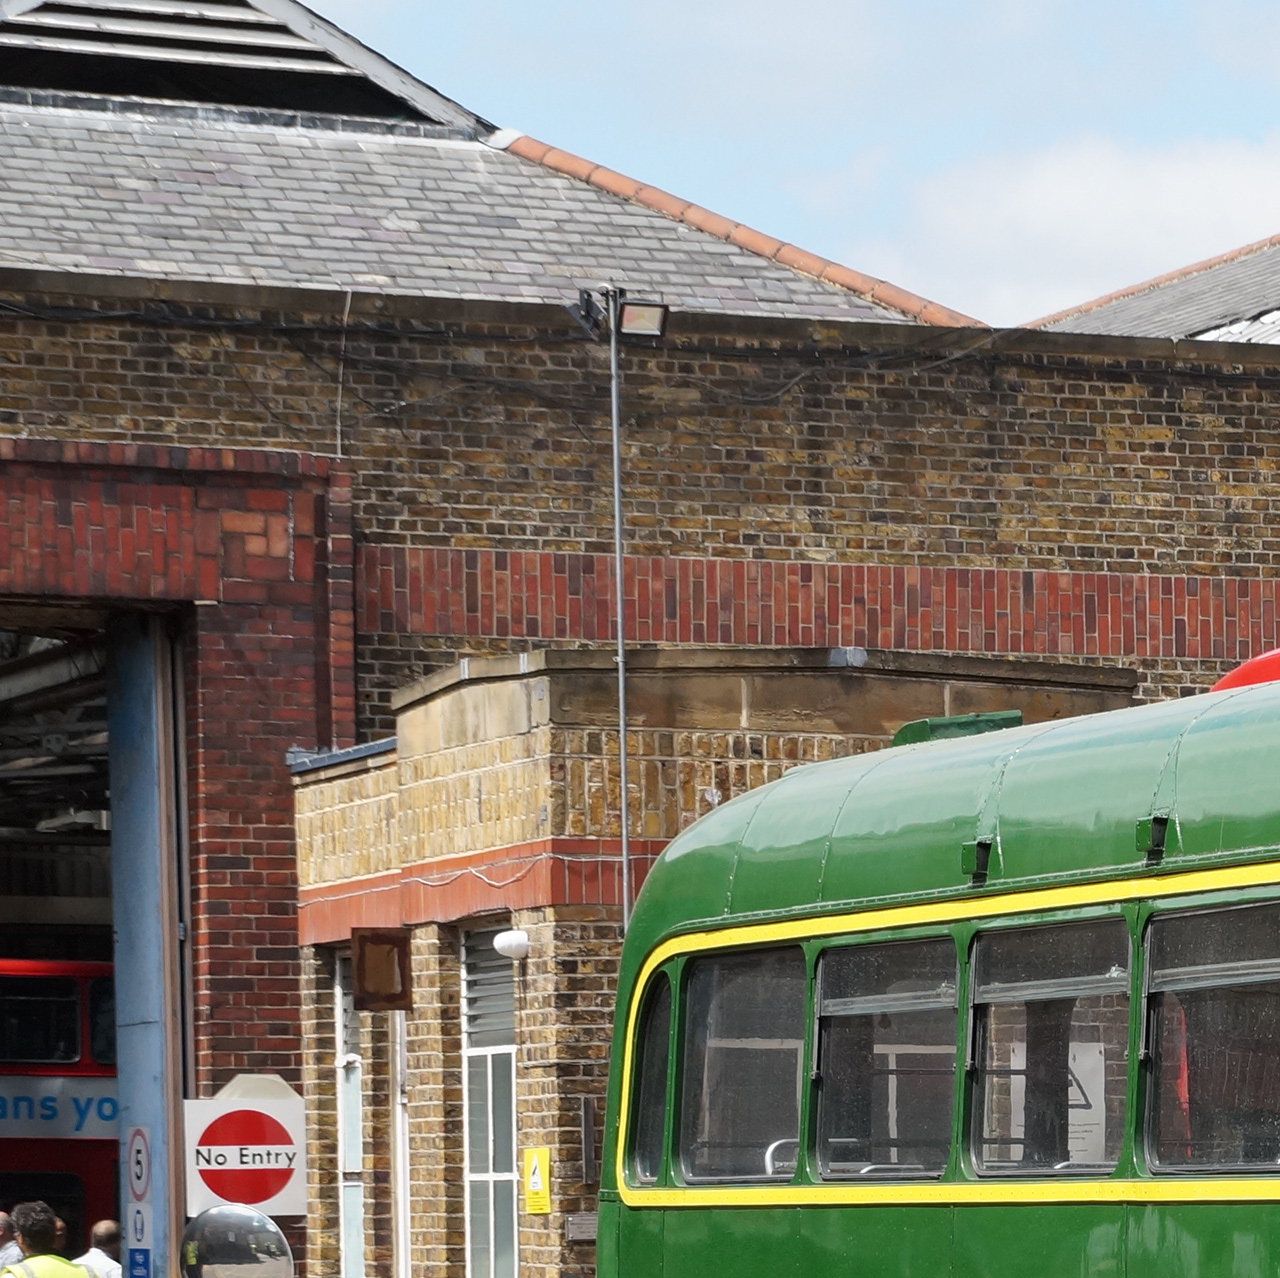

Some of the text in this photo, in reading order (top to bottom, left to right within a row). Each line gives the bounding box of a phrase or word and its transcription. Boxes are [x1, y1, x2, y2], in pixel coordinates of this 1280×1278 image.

[135, 1148, 144, 1181] 5
[195, 1147, 297, 1168] No Entry
